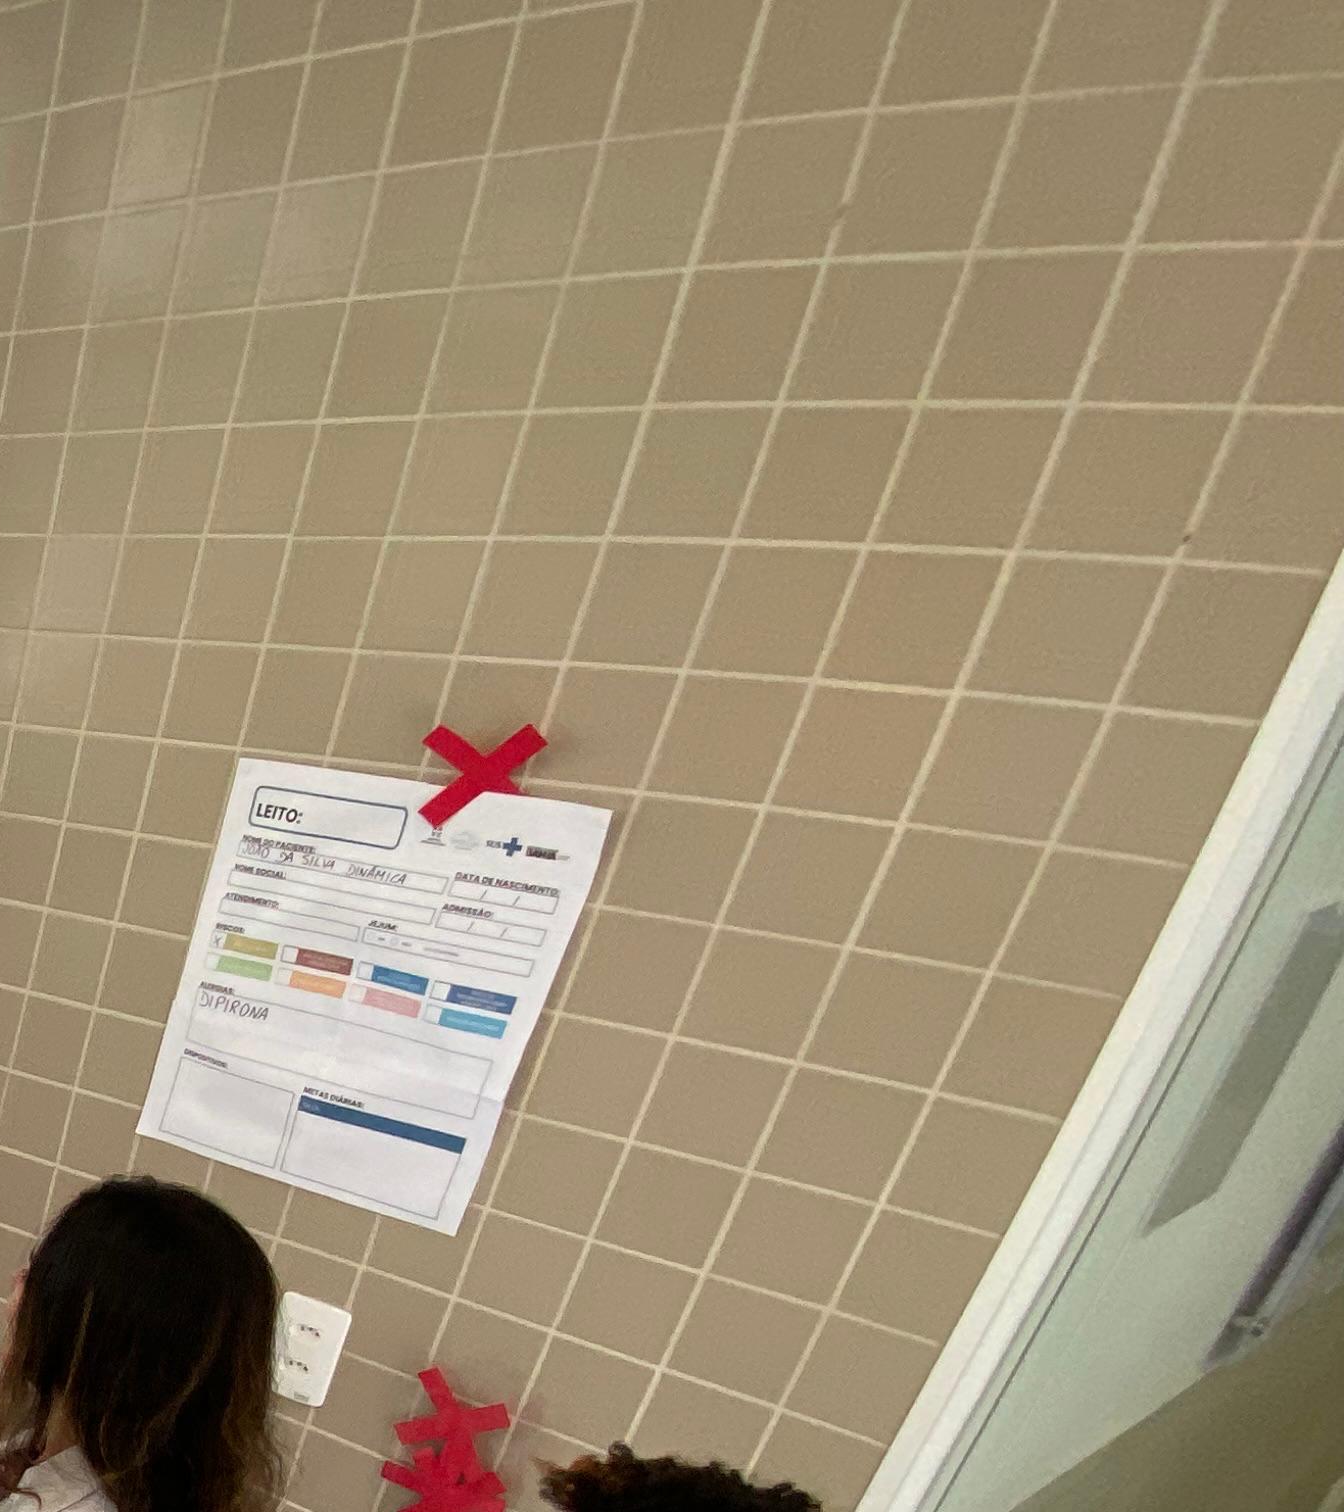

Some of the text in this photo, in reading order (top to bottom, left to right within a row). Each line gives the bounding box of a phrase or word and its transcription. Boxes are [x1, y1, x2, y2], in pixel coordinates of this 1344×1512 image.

[255, 803, 303, 824] LEITO:
[302, 854, 335, 870] SILVA
[454, 871, 481, 884] DATA
[494, 878, 560, 898] NASCIMENTO:
[442, 903, 494, 919] ADMISSÃO:
[199, 990, 269, 1021] DIPIRONA
[303, 1086, 329, 1099] METAS
